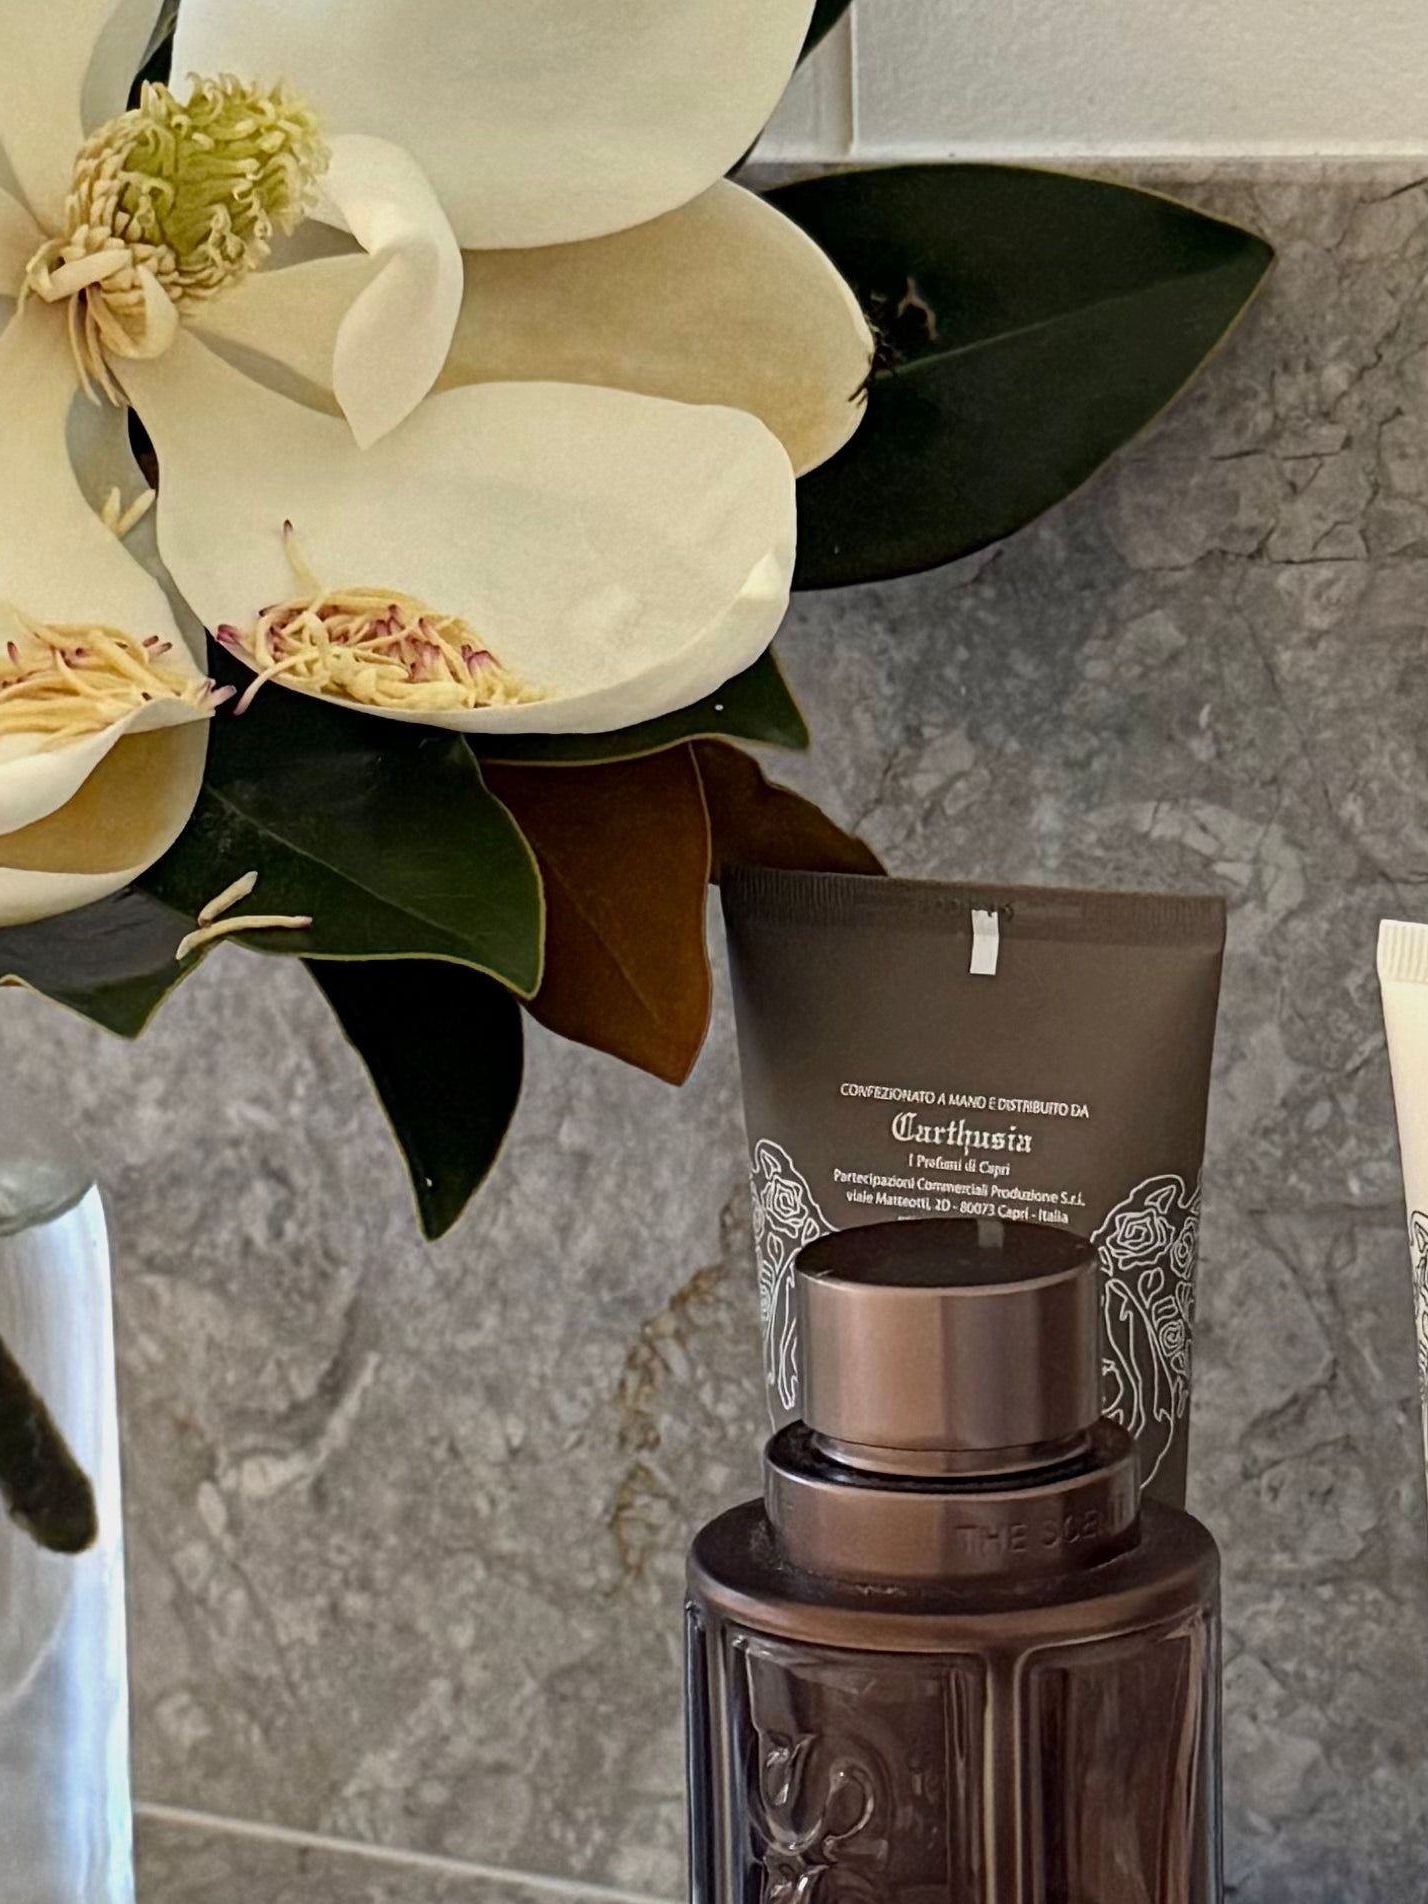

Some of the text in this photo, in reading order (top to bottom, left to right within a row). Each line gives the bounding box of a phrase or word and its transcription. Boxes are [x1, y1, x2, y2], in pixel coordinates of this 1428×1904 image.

[840, 1082, 1090, 1118] CONFEZIONATO A MANO E DISTRIBUITO DA
[891, 1111, 1033, 1157] Carthusia
[833, 1169, 915, 1190] Partecipazioni
[917, 1177, 988, 1198] Commerciali
[991, 1184, 1057, 1203] Produzione
[964, 1158, 976, 1172] di
[978, 1160, 1011, 1180] Capri
[960, 1202, 996, 1217] 80073
[998, 1204, 1028, 1222] Capri
[1038, 1209, 1069, 1224] Italia
